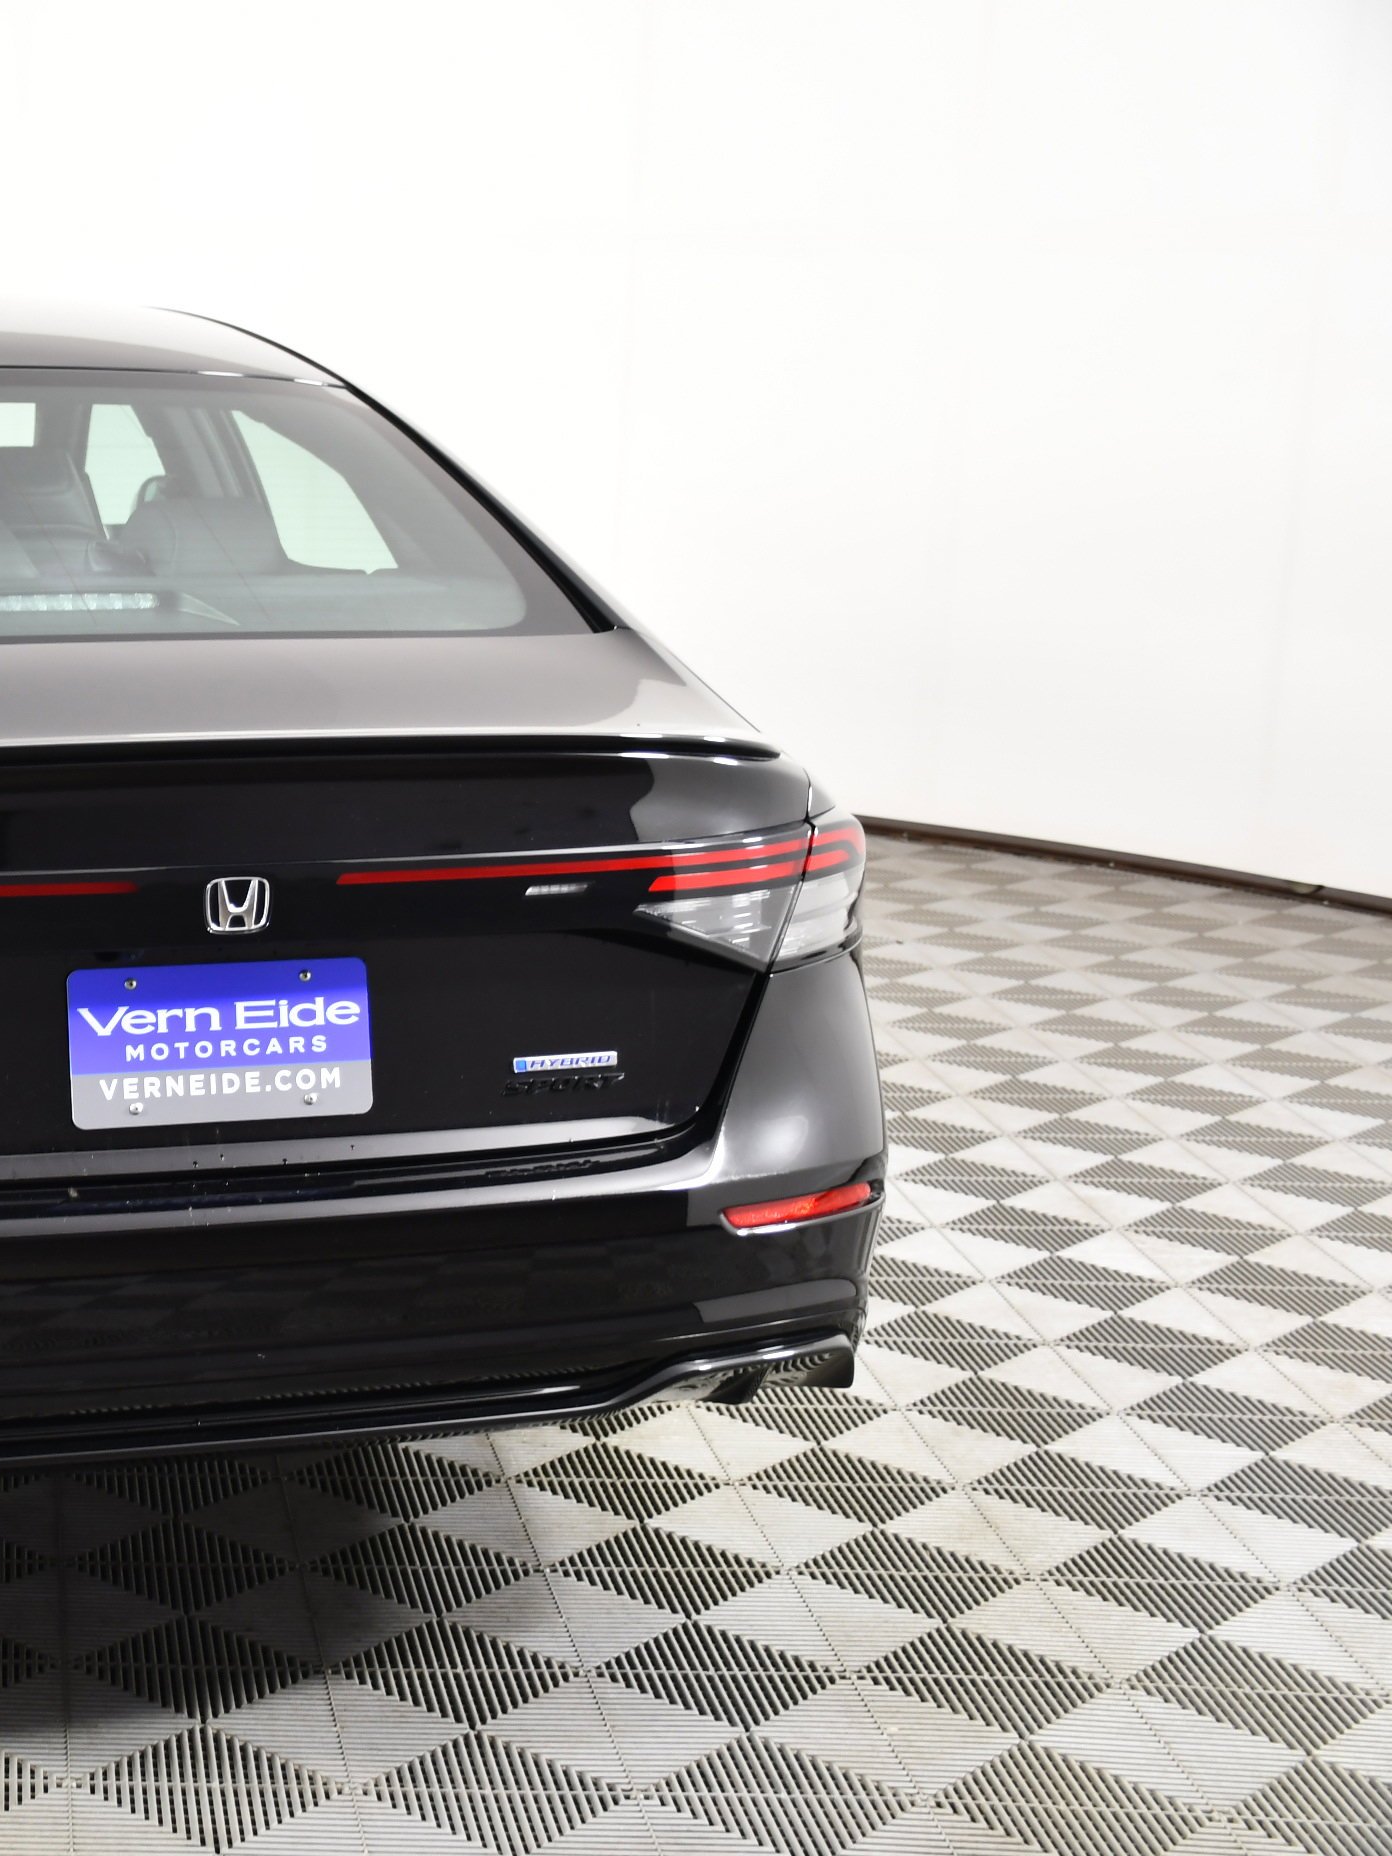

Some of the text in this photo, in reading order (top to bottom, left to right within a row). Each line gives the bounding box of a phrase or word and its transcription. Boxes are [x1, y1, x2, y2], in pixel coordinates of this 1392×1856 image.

[77, 997, 360, 1036] Vern Eide
[125, 1035, 327, 1062] MOTORCARS
[530, 1055, 611, 1069] HYBRID
[99, 1067, 341, 1100] VERNEIDE.COM
[500, 1072, 625, 1096] SPORT
